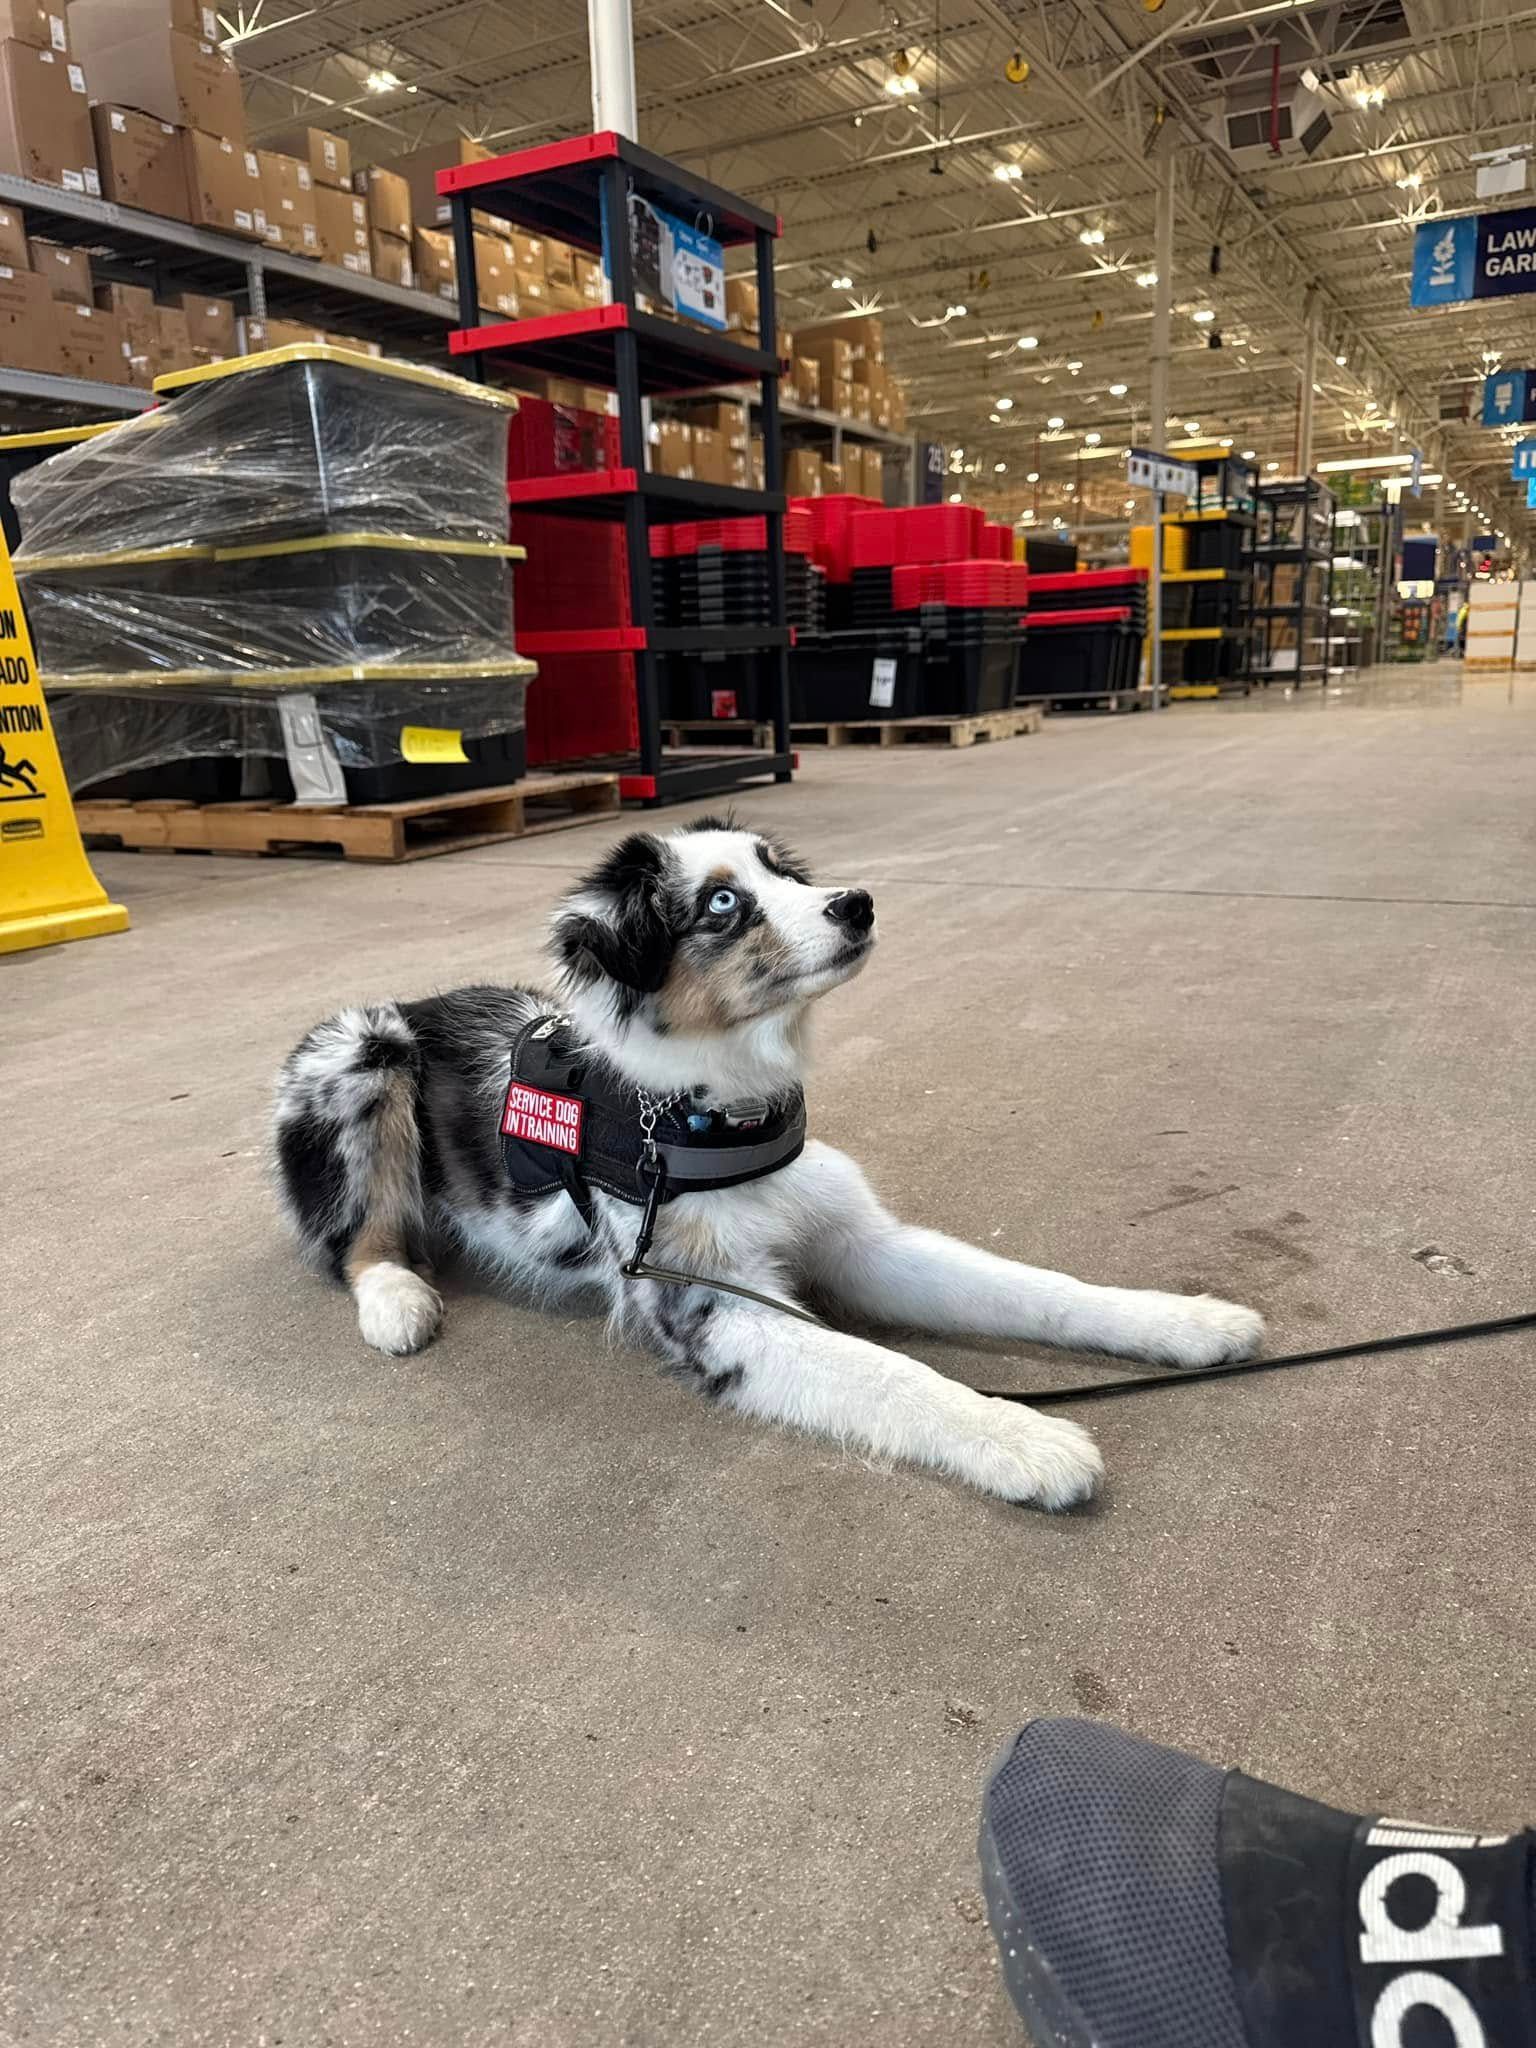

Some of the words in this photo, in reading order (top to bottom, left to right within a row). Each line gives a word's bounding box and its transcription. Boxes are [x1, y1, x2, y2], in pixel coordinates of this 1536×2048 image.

[1487, 227, 1536, 253] LAW
[509, 1086, 553, 1119] SERVICE
[555, 1100, 579, 1127] DOG
[505, 1109, 520, 1134] IN
[520, 1113, 577, 1150] TRAINING
